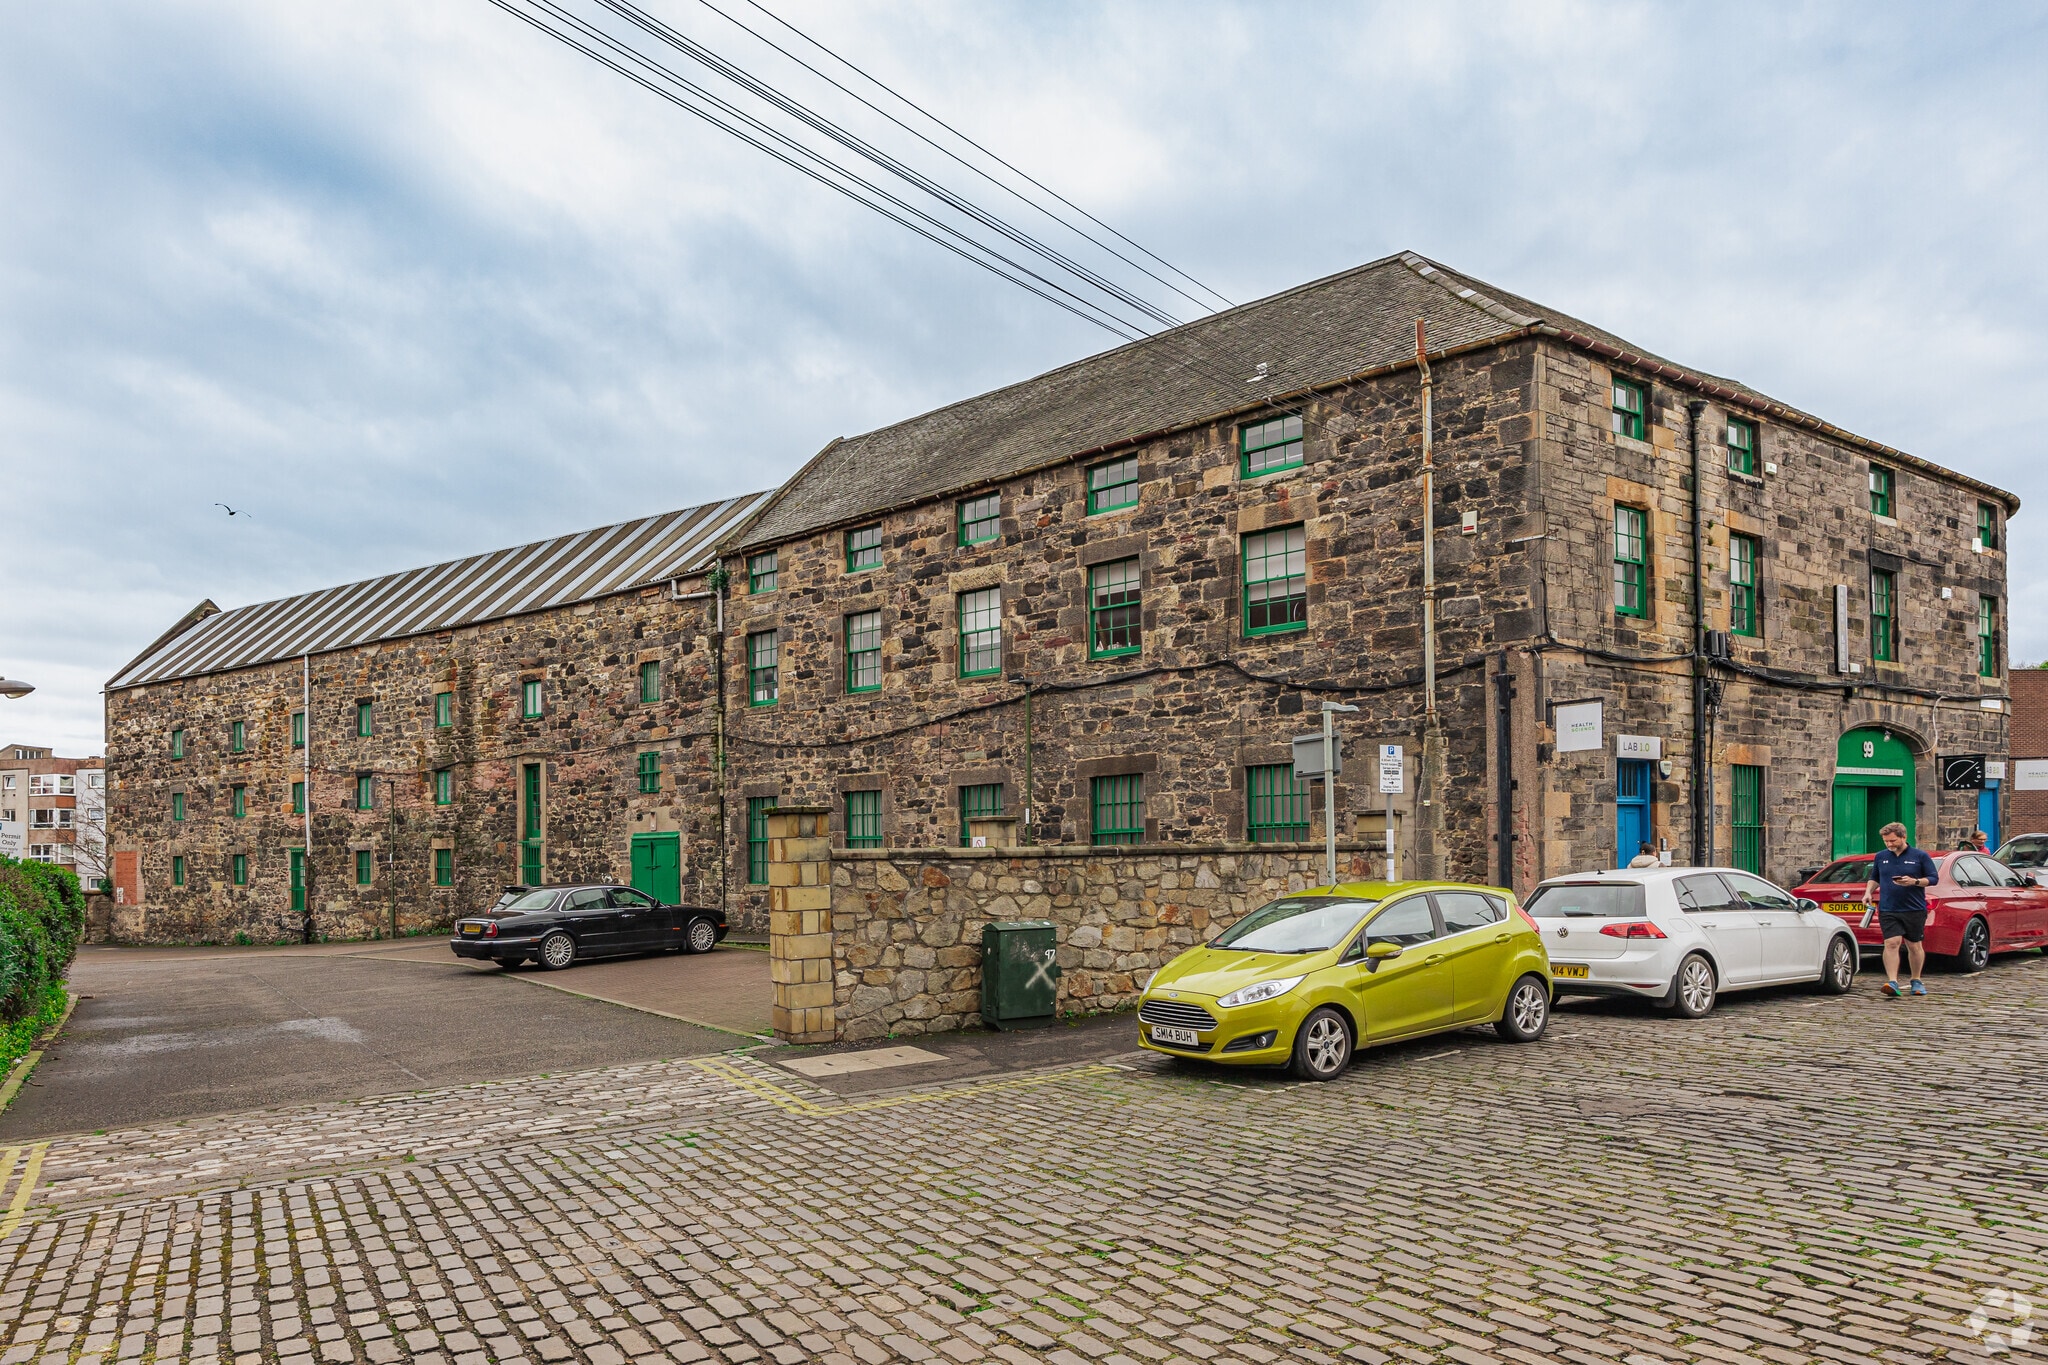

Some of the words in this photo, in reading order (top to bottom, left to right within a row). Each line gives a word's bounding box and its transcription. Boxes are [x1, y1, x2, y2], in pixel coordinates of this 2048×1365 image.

[1623, 742, 1638, 751] LAB
[1640, 742, 1650, 752] 1.0
[1863, 741, 1874, 758] 99
[1567, 967, 1585, 977] VWJ
[1155, 1027, 1174, 1040] SM14
[1175, 1029, 1192, 1043] BUH
